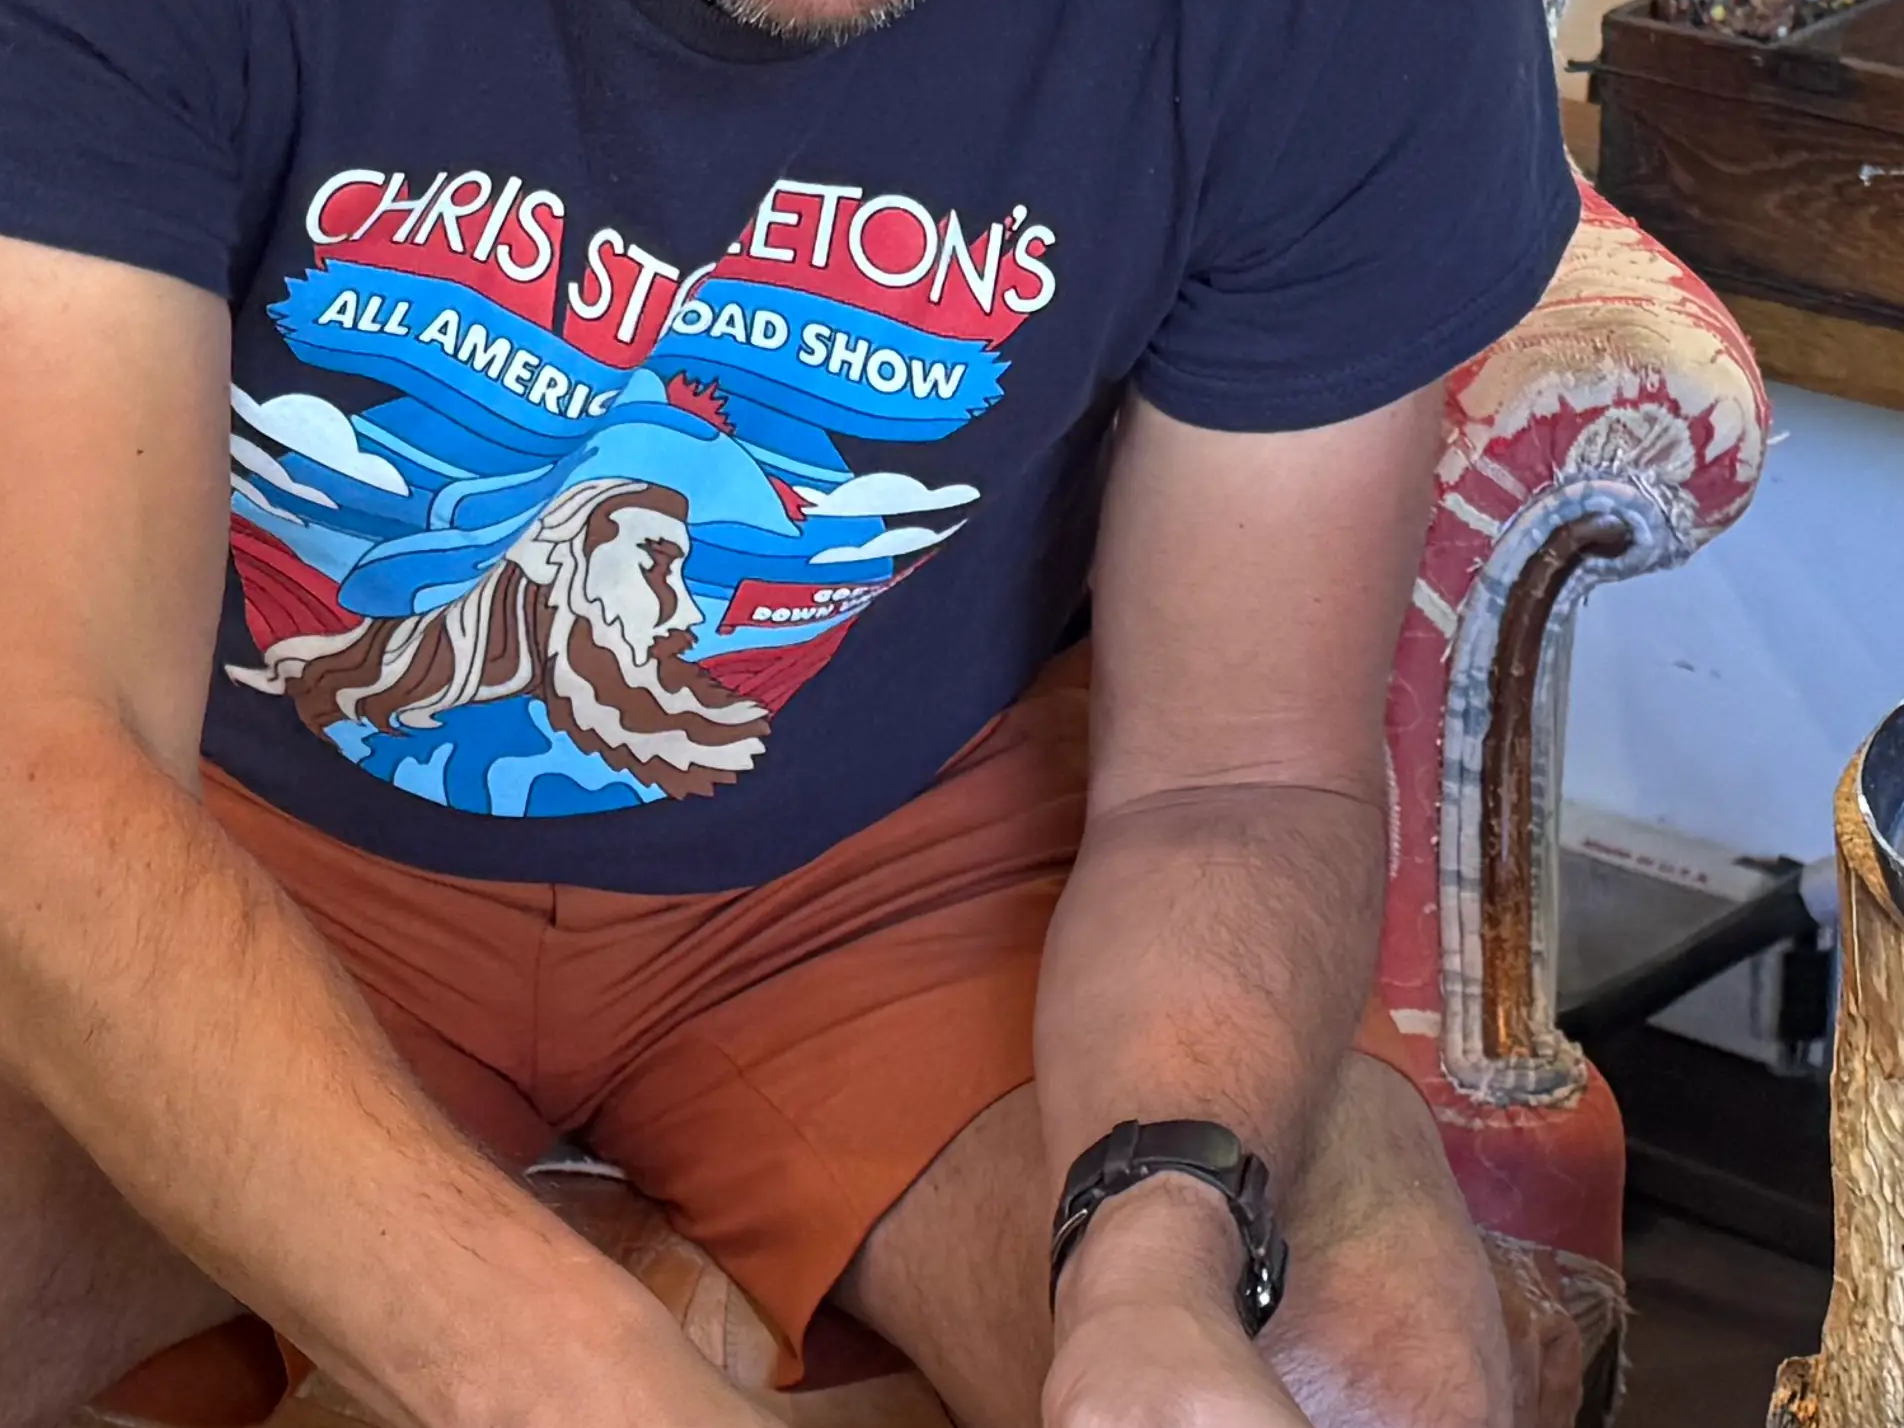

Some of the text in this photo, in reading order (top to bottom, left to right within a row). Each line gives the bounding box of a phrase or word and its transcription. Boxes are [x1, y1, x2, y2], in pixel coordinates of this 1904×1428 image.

[305, 168, 566, 283] CHRIS
[316, 288, 411, 336] ALL
[671, 298, 789, 351] OAD
[797, 322, 968, 401] SHOW
